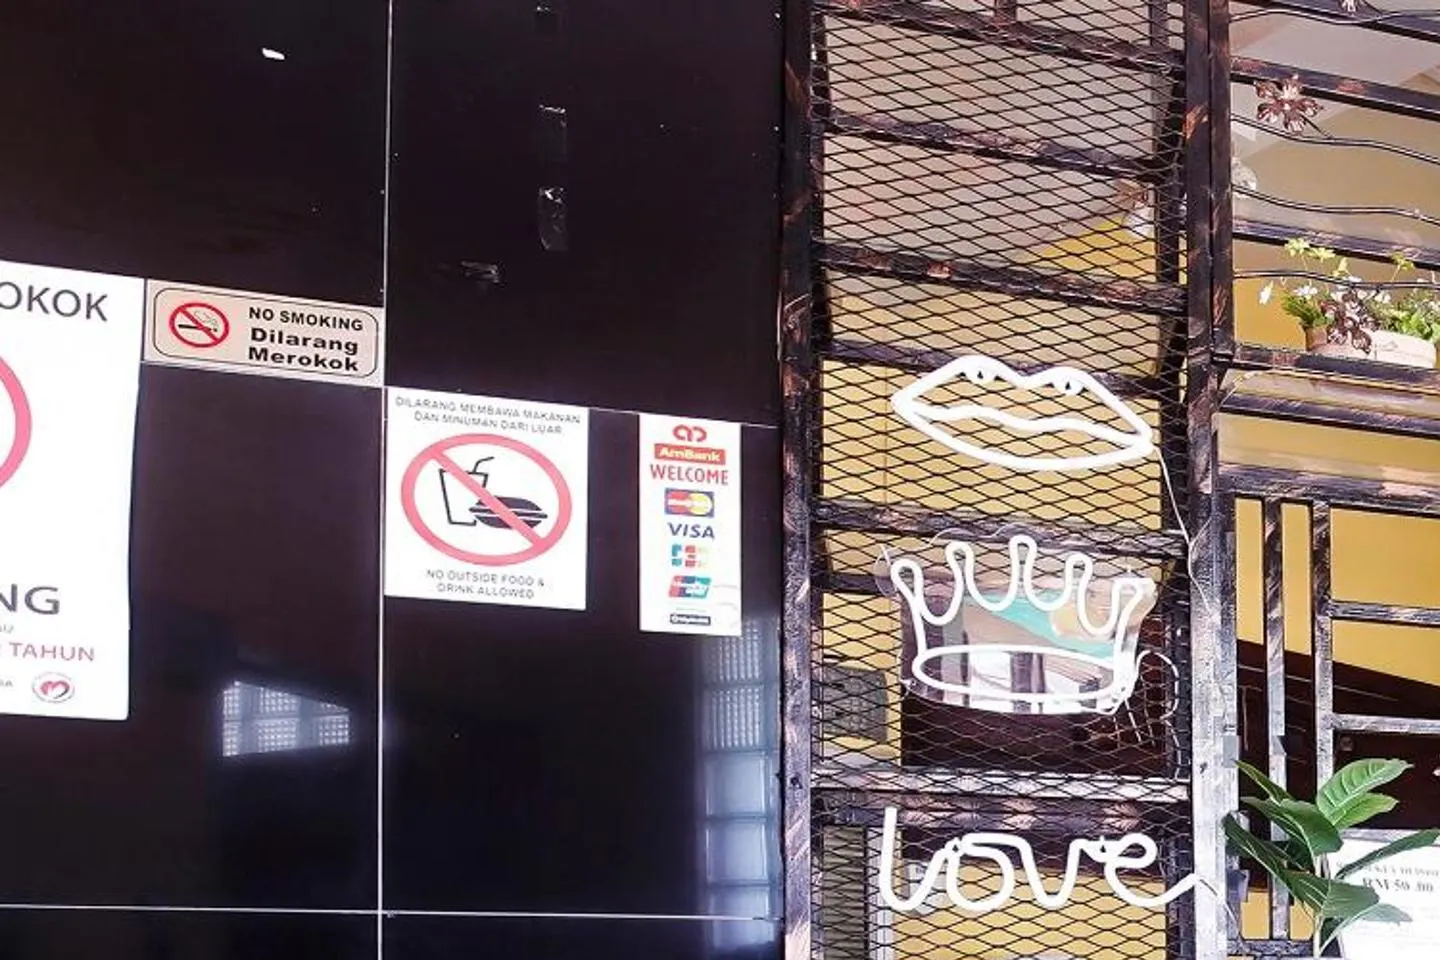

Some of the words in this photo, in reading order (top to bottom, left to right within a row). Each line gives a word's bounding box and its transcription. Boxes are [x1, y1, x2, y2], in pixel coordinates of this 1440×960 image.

[0, 281, 107, 322] OKOK
[249, 307, 274, 321] NO
[280, 310, 363, 331] SMOKING
[251, 327, 358, 355] Dilarang
[248, 347, 358, 371] Merokok
[396, 396, 456, 411] DILARANG
[459, 402, 520, 418] MEMBAWA
[523, 408, 581, 424] MAKANAN
[414, 410, 439, 422] DAN
[442, 413, 498, 428] MINUMAN
[500, 419, 529, 431] DARI
[531, 423, 563, 434] LUAR
[650, 463, 728, 486] WELCOME
[667, 522, 715, 539] VISA
[427, 569, 444, 580] NO
[447, 570, 498, 584] OUTSIDE
[501, 575, 535, 587] FOOD
[436, 583, 474, 594] DRINK
[478, 586, 535, 600] ALLOWED
[9, 641, 94, 662] TAHUN
